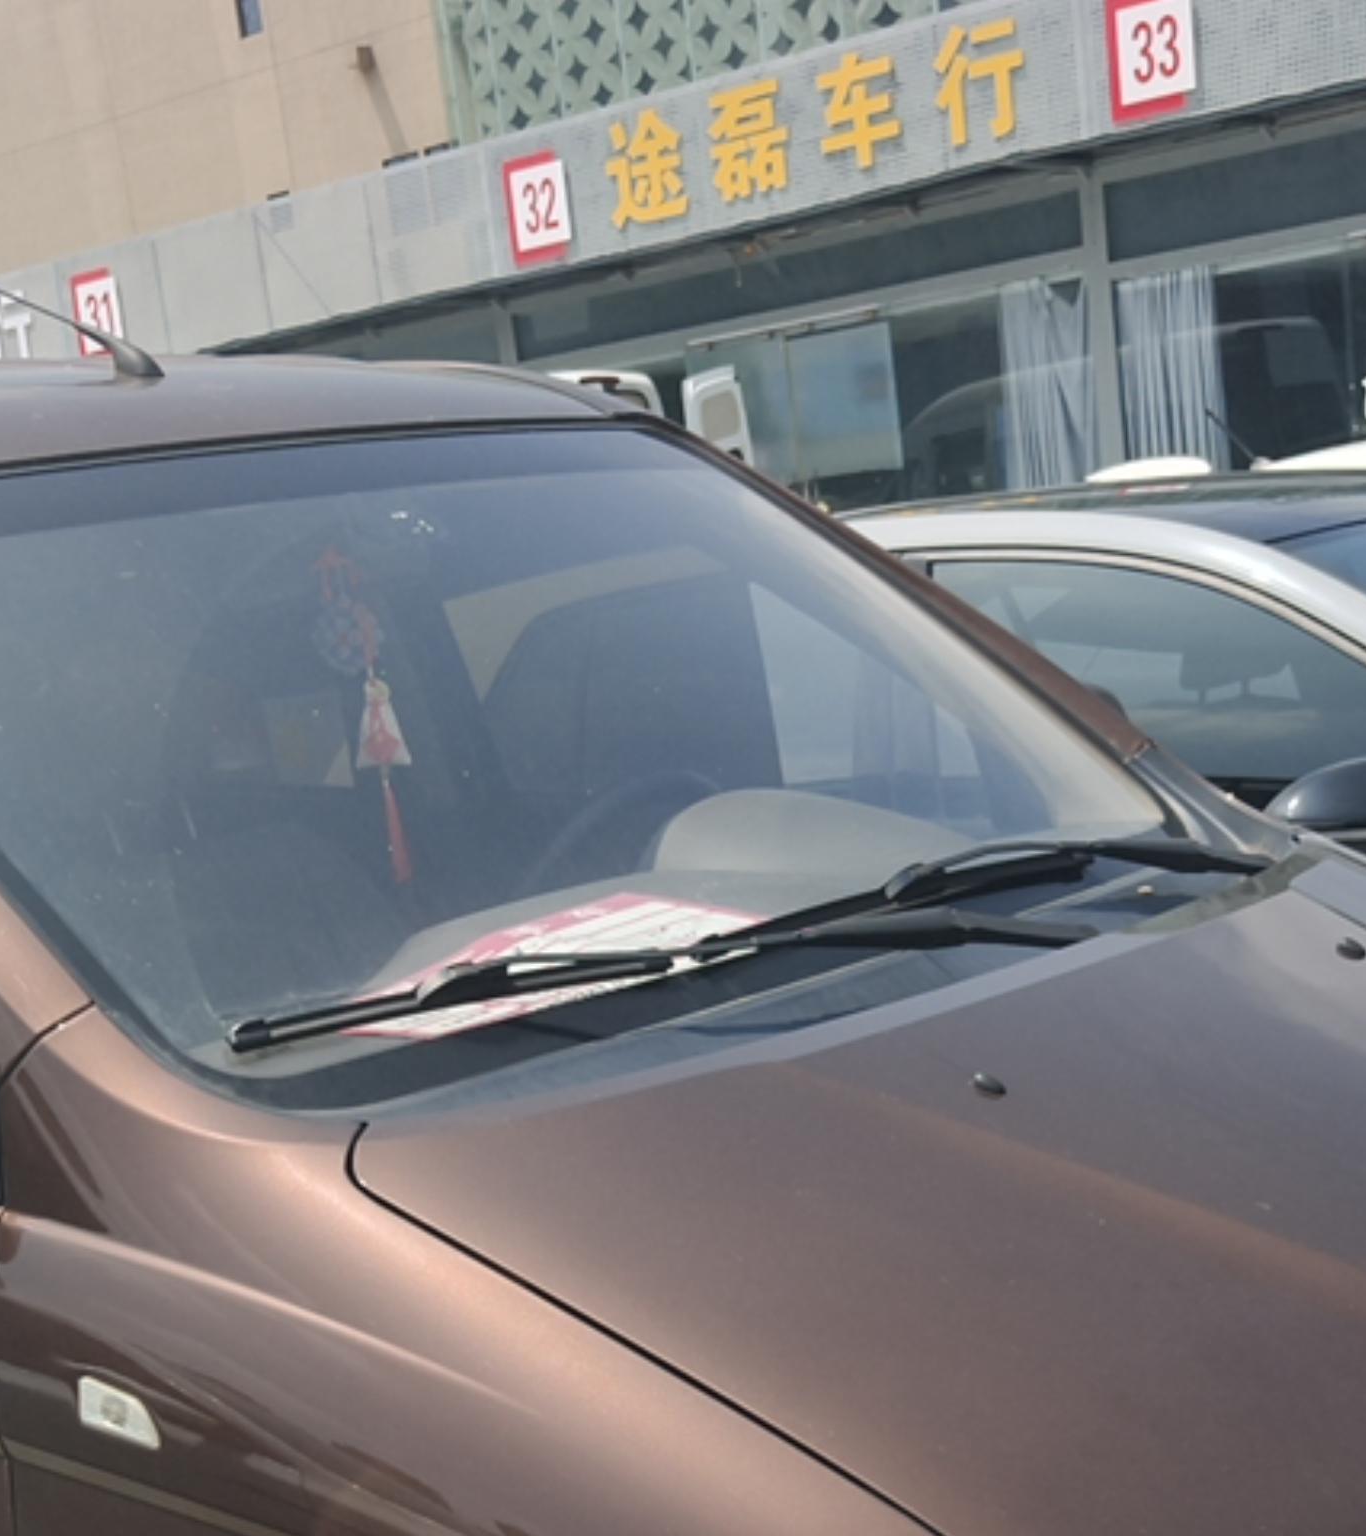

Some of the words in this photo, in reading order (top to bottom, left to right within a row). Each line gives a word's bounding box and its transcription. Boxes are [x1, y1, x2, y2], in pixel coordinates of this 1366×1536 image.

[1131, 14, 1181, 83] 33
[604, 18, 1025, 230] 途磊车行
[521, 178, 560, 235] 32
